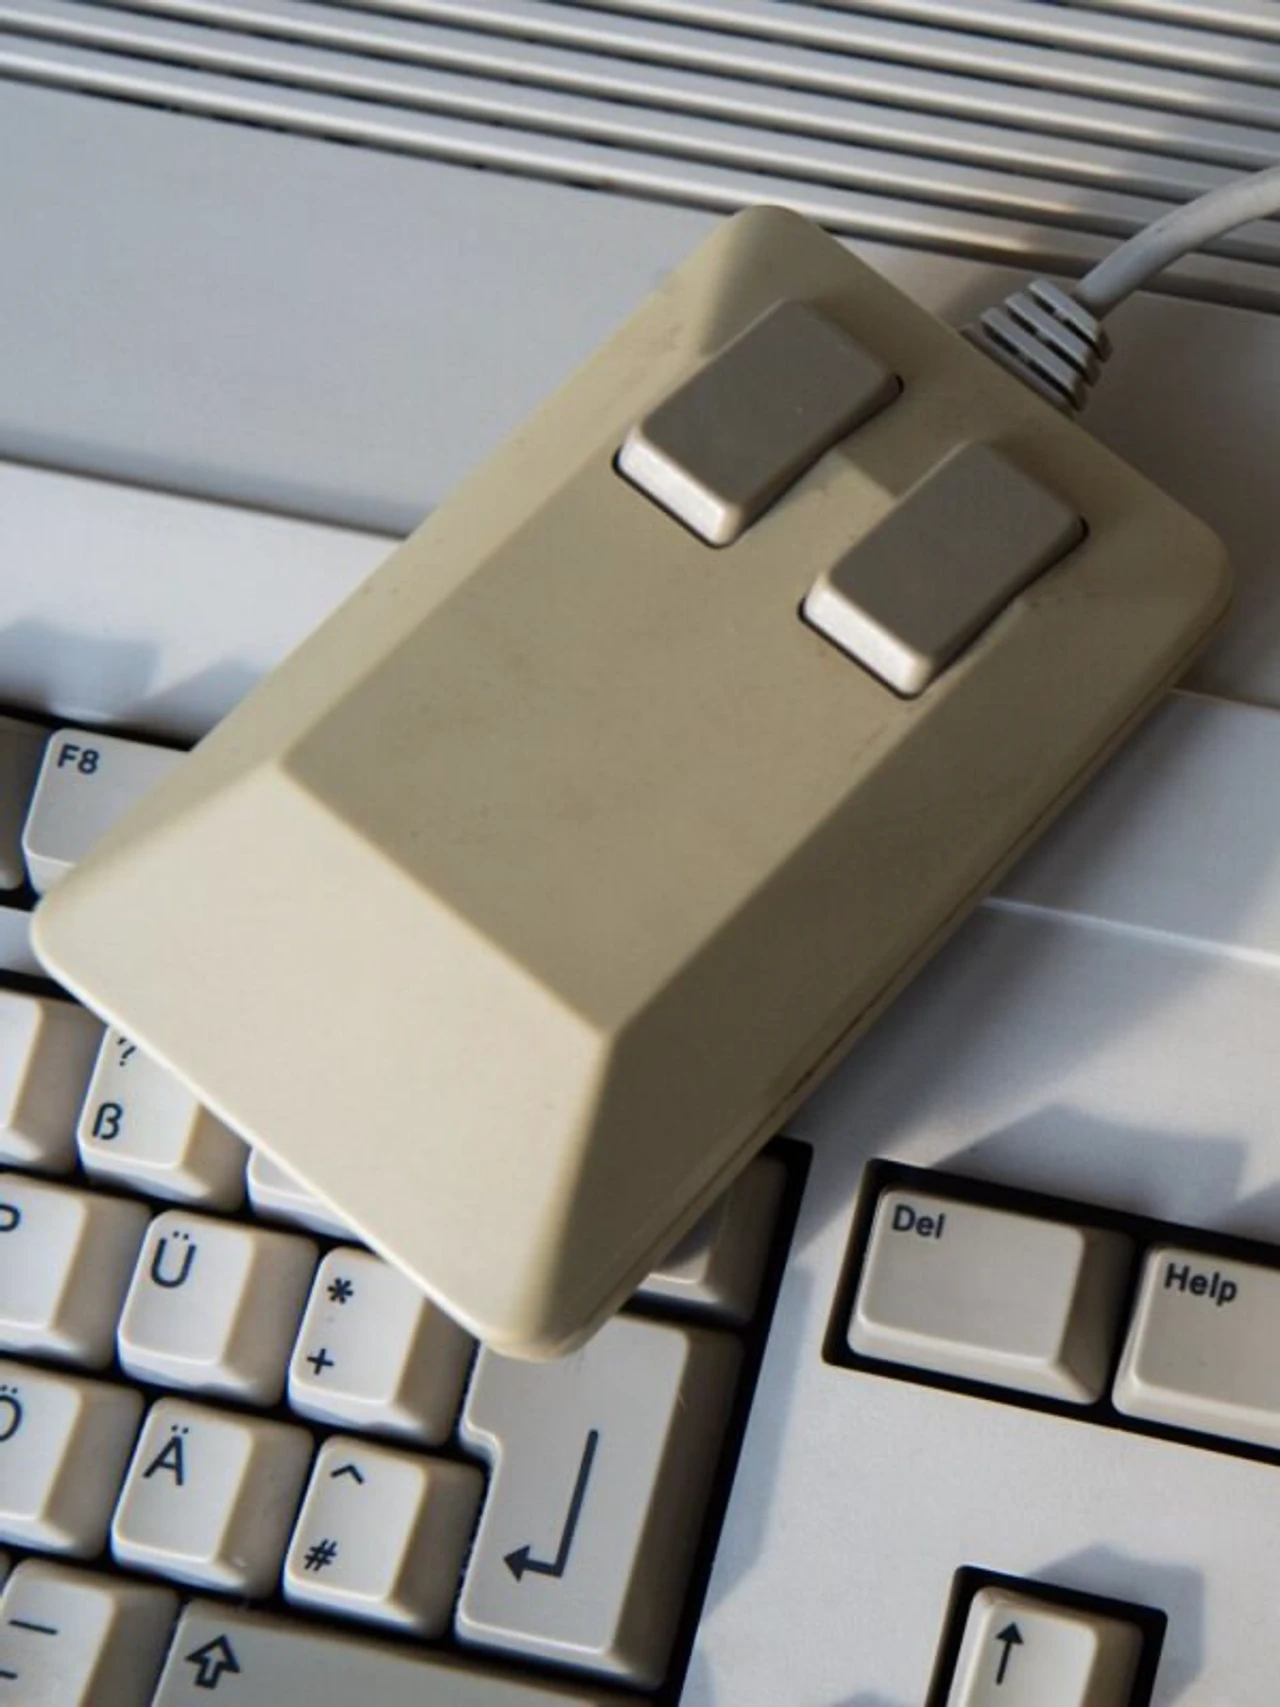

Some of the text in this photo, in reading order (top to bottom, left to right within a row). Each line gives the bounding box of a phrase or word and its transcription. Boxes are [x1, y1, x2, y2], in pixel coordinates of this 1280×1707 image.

[57, 743, 100, 775] F8
[891, 1204, 946, 1240] Del
[150, 1230, 197, 1288] Ü
[1164, 1262, 1238, 1307] Help
[143, 1425, 189, 1486] Ä
